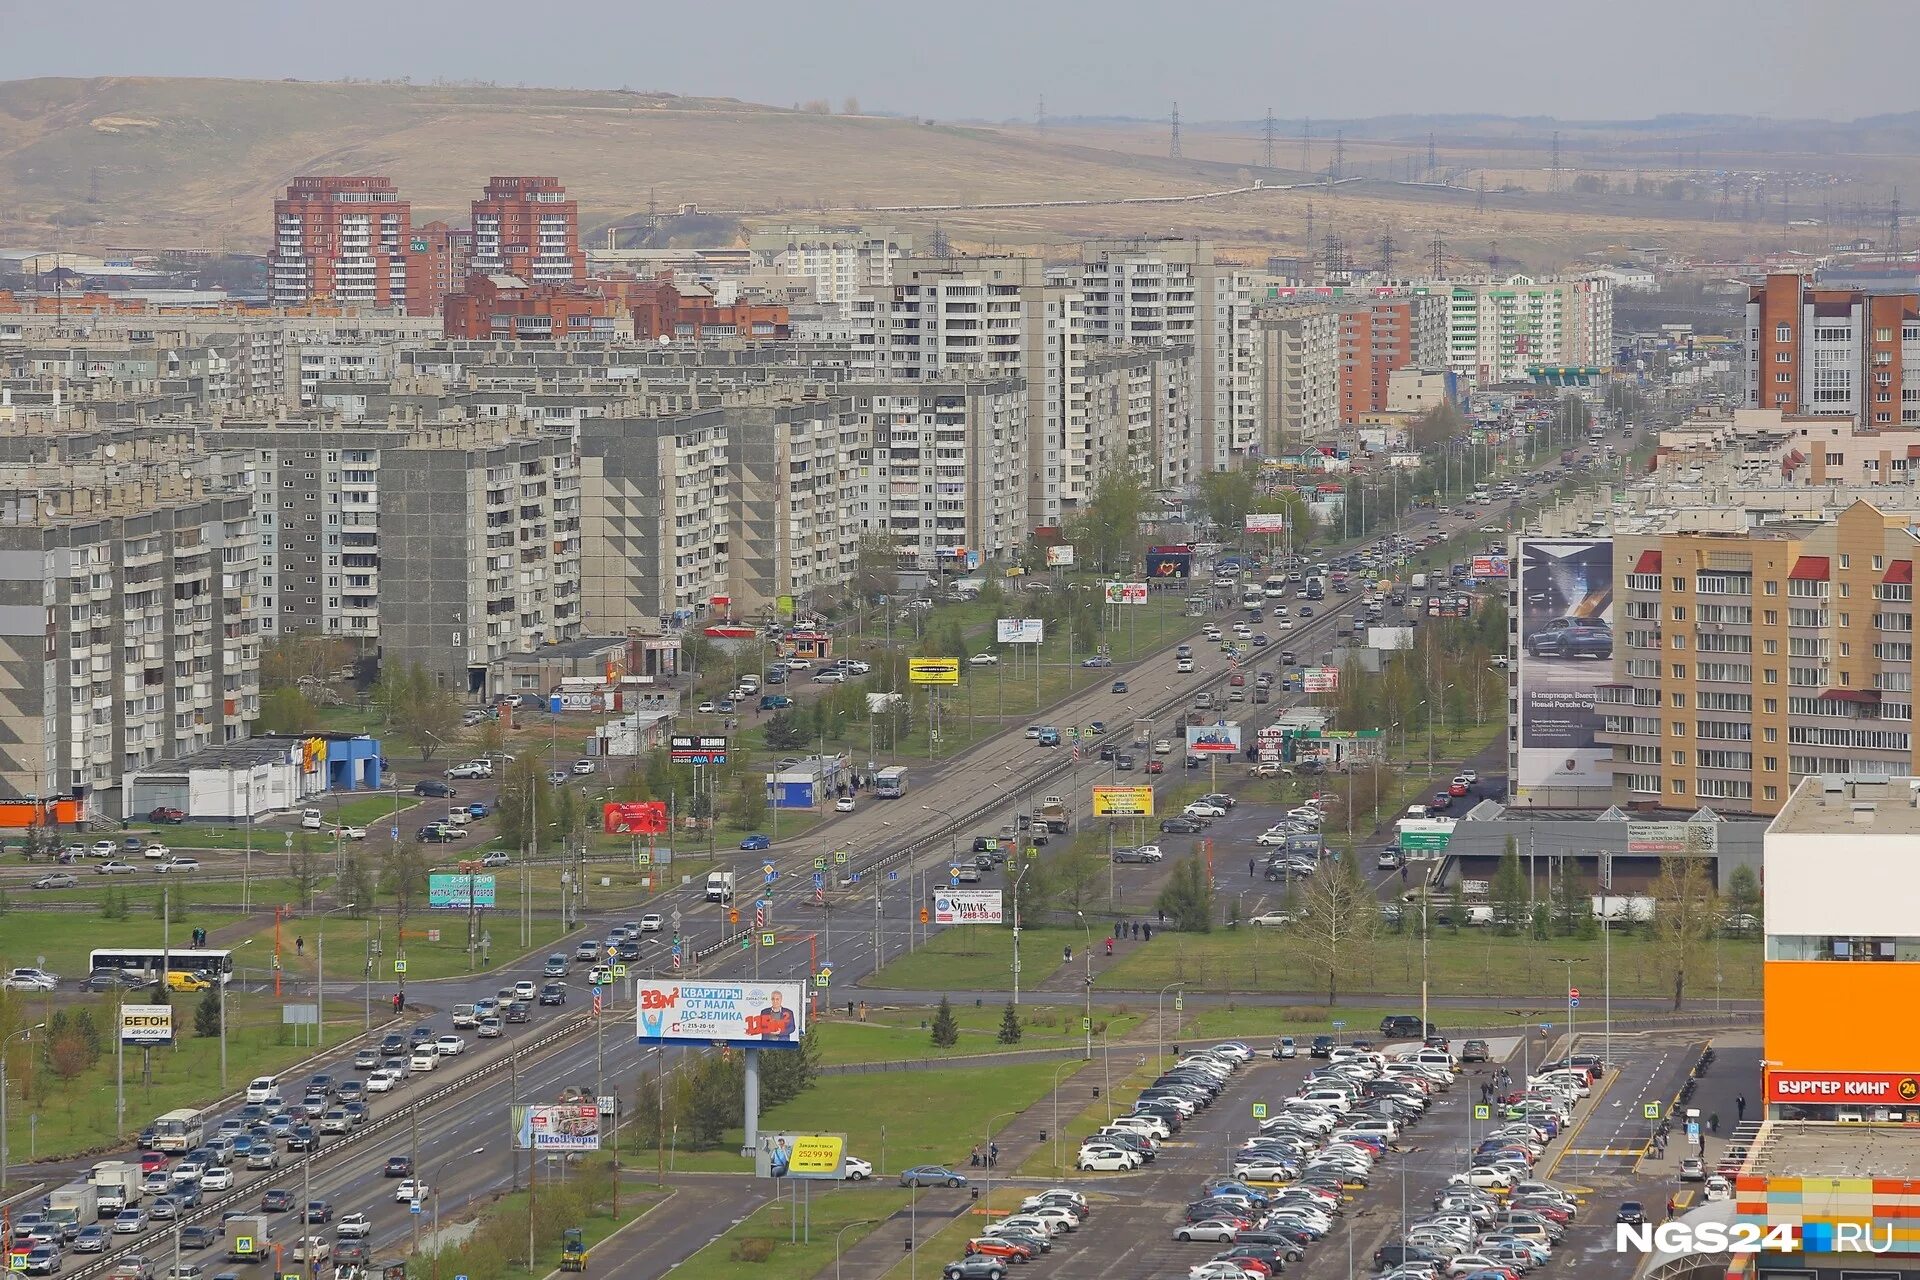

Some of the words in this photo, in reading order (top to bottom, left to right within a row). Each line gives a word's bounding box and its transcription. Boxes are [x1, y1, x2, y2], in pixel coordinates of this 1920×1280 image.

[1538, 692, 1574, 700] спорткаре.
[672, 738, 692, 746] ОКНА
[700, 738, 725, 746] REHAU
[640, 987, 679, 1010] 33м²
[682, 989, 742, 999] КВАРТИРЫ
[704, 1000, 735, 1010] МАЛА
[680, 1011, 698, 1020] ДО
[125, 1016, 168, 1026] БЕТОН
[1778, 1081, 1840, 1094] БУРГЕР
[1844, 1082, 1889, 1094] КИНГ
[1902, 1083, 1916, 1094] 24
